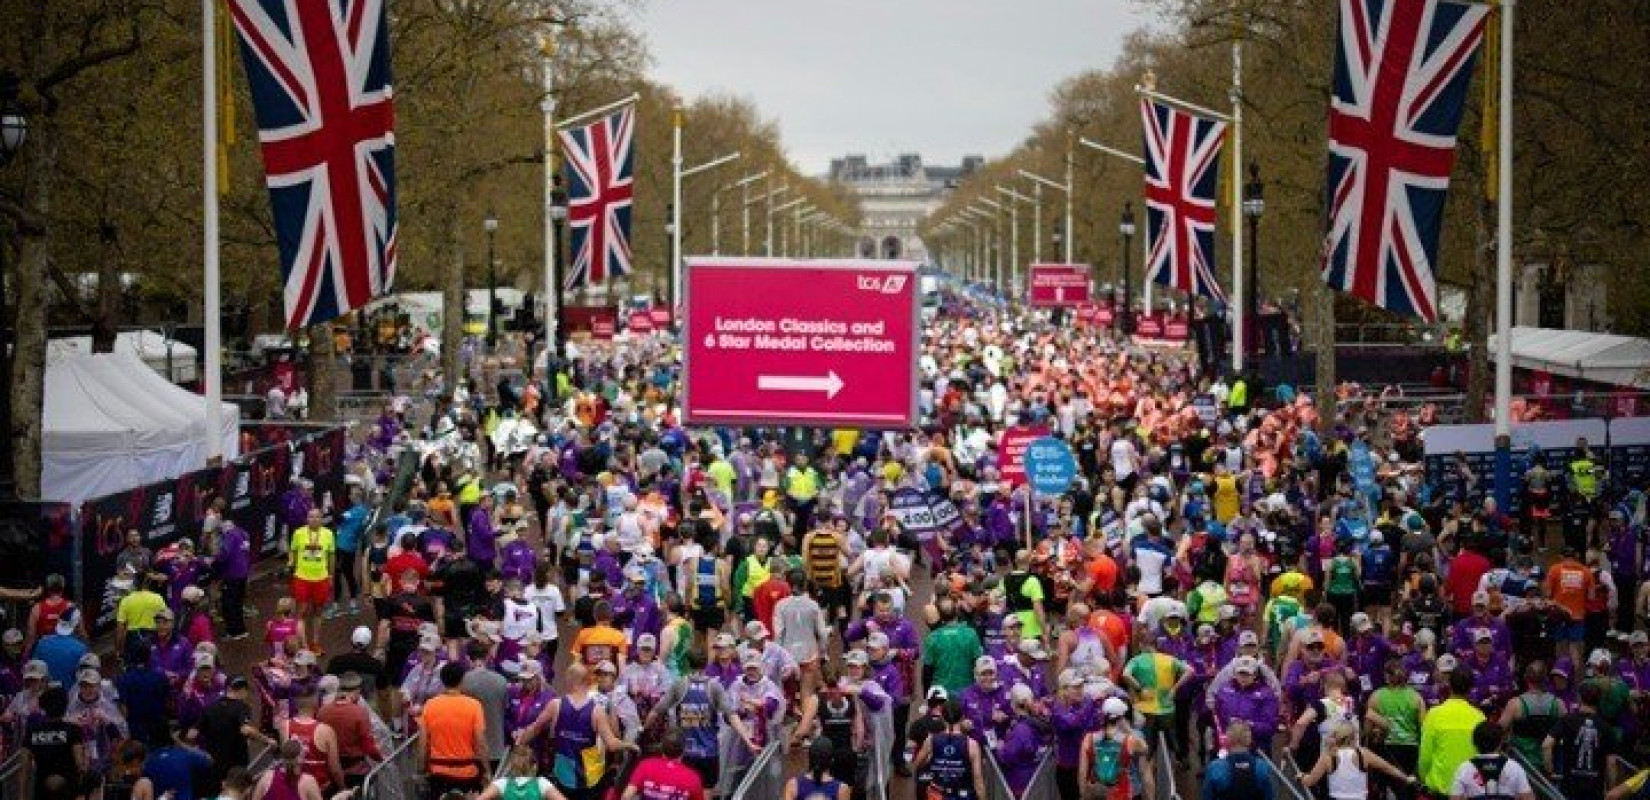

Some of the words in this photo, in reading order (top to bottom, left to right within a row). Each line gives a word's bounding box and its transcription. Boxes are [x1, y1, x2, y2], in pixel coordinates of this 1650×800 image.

[857, 275, 880, 290] tcs
[714, 316, 776, 332] London
[779, 318, 847, 334] Classics
[851, 320, 885, 336] and
[704, 334, 715, 348] 6
[718, 335, 751, 349] Star
[754, 335, 807, 350] Medal
[810, 336, 895, 352] Collection
